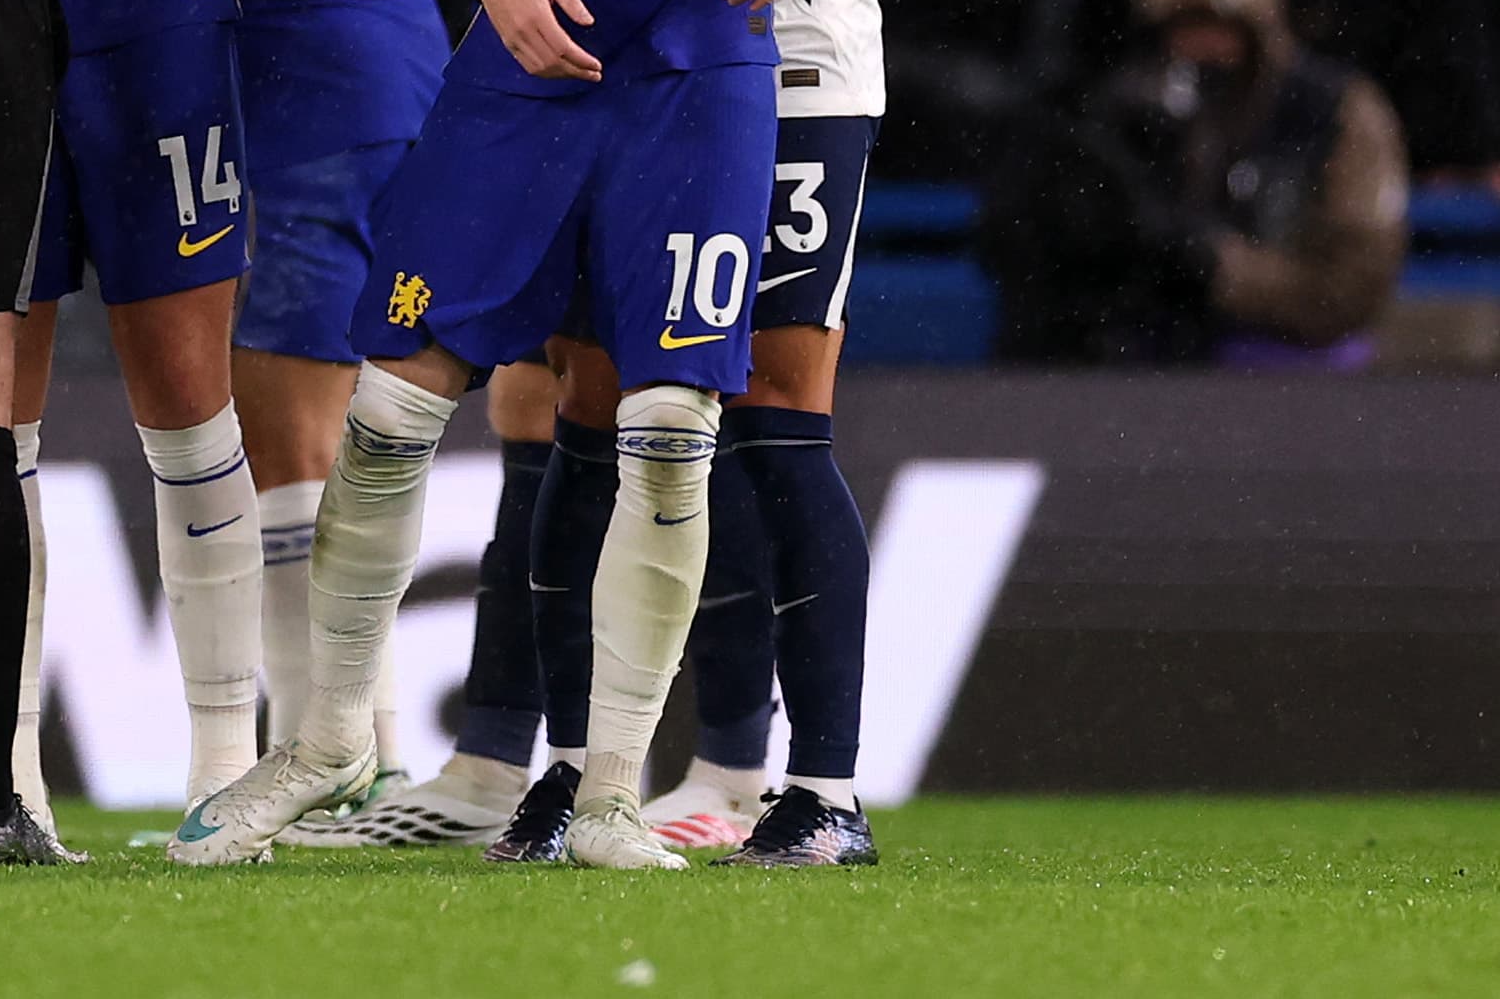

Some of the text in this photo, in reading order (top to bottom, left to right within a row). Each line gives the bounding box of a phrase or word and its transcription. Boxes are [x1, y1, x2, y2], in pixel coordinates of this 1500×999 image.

[158, 125, 242, 227] 14
[761, 162, 829, 253] 3
[664, 233, 750, 328] 10
